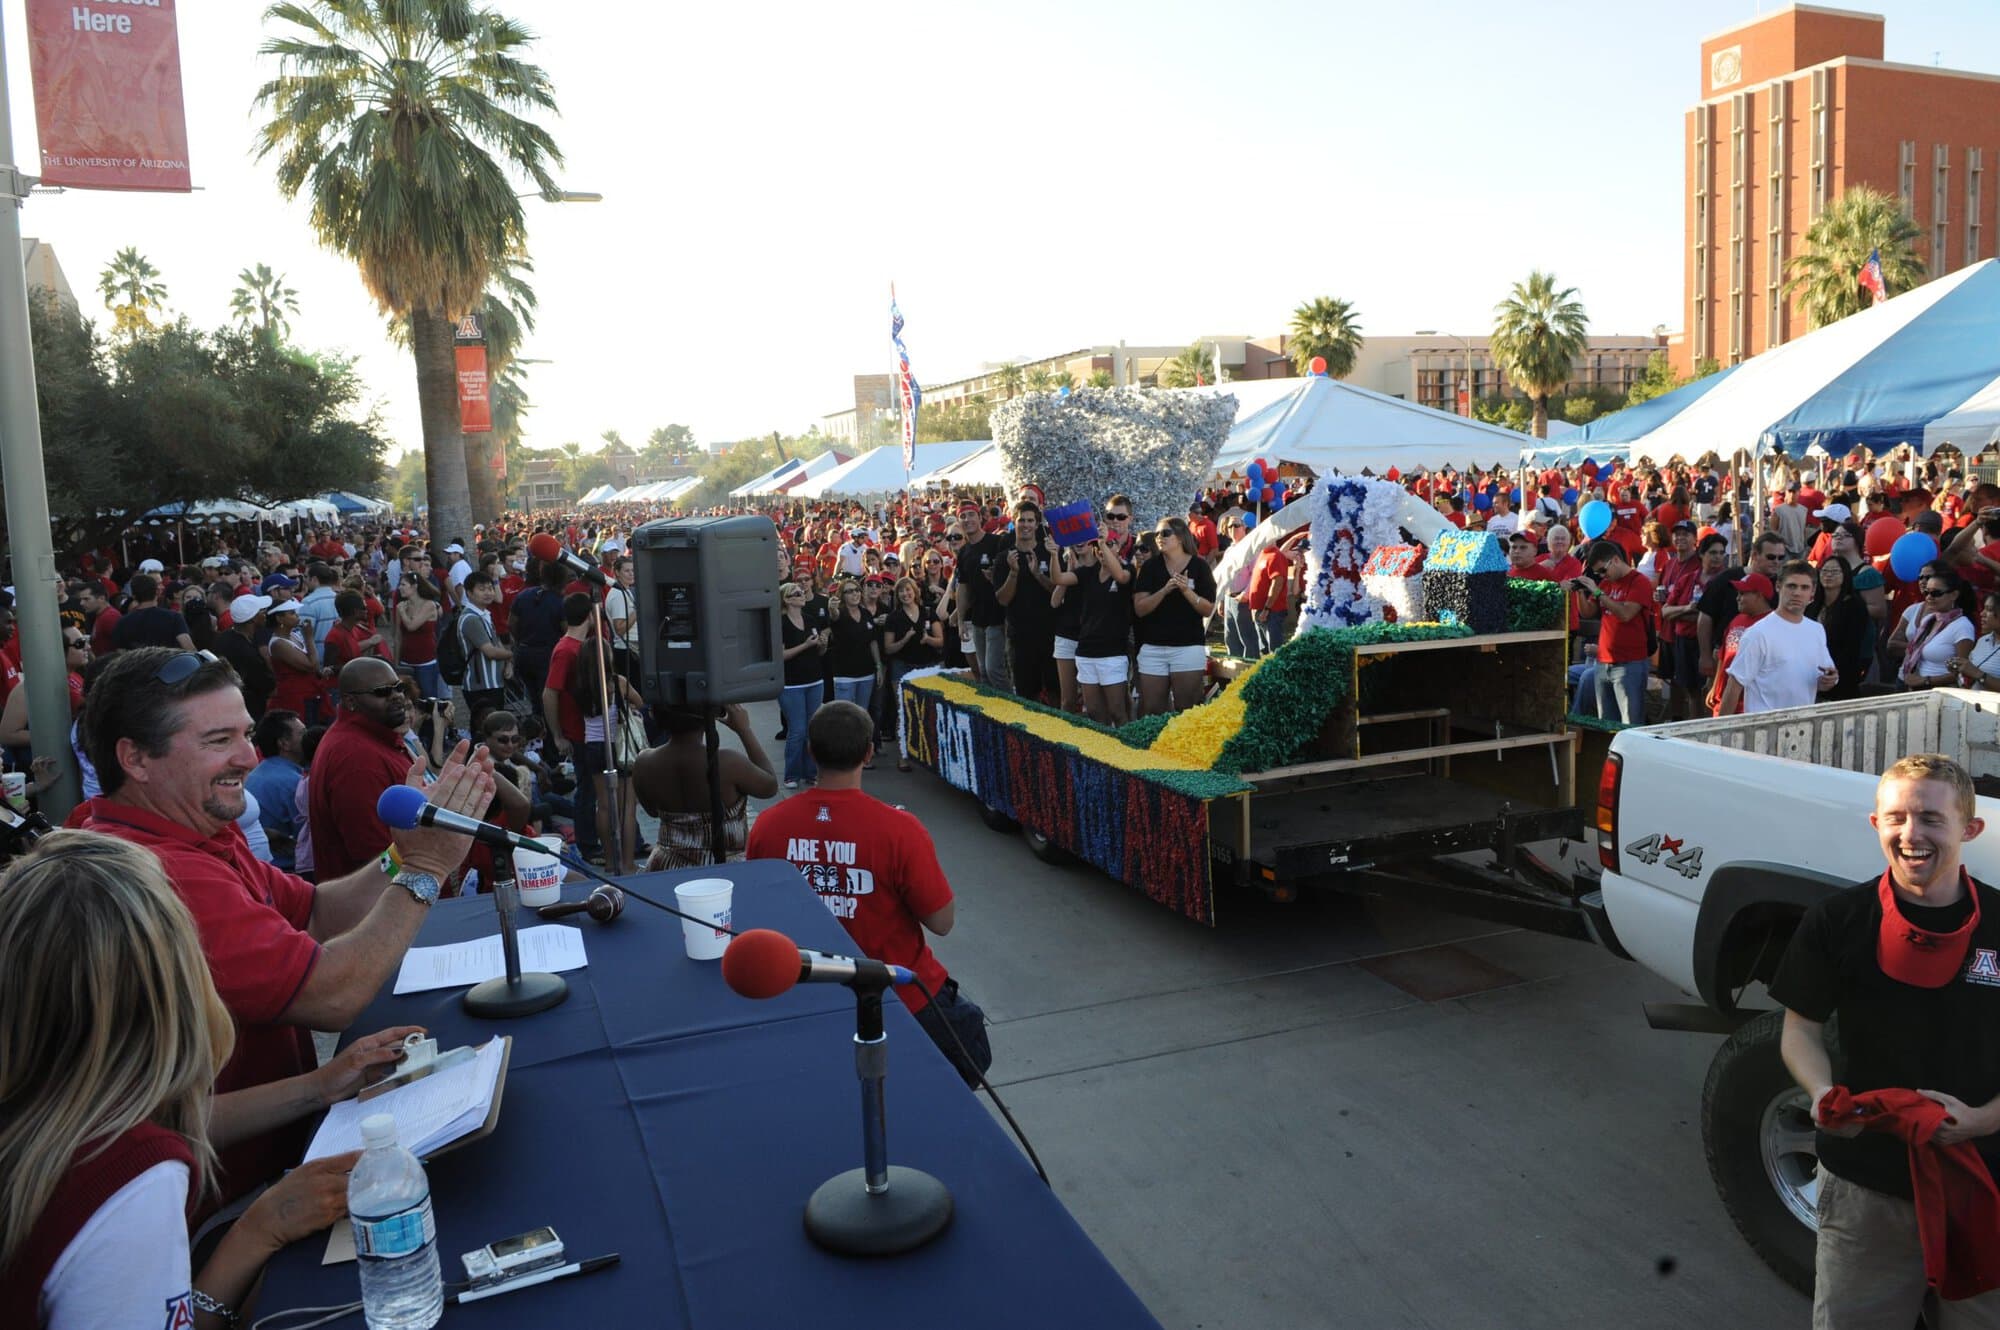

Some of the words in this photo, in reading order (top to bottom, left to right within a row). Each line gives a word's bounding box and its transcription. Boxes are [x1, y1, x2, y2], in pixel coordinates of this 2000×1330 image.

[72, 7, 132, 34] Here
[43, 156, 61, 166] THE
[65, 157, 121, 167] UNIVERSITY
[123, 158, 136, 168] OF
[139, 157, 185, 169] ARIZONA
[786, 838, 819, 862] ARE
[824, 840, 856, 865] YOU
[523, 871, 537, 880] YOU
[541, 869, 555, 879] CAN
[520, 875, 559, 889] REMEMBER
